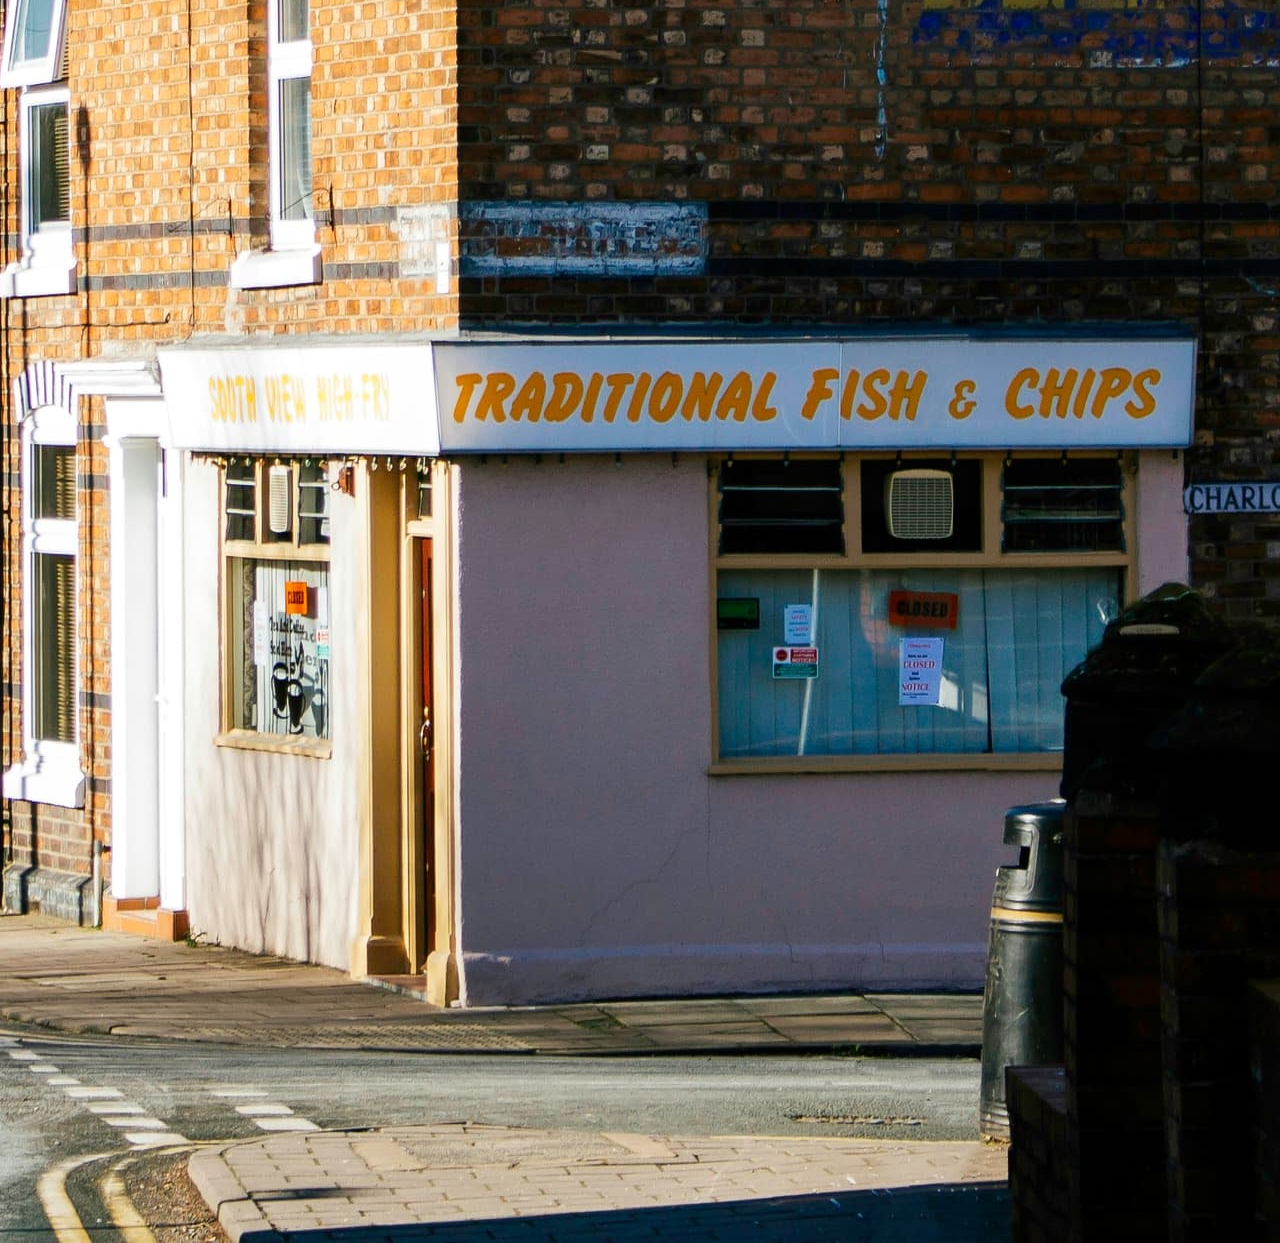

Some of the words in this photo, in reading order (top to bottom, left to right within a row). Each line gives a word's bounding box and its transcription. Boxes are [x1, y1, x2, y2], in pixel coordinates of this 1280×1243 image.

[208, 373, 257, 423] SOUTH
[264, 373, 306, 423] VIEW
[453, 371, 777, 423] TRADITIONAL
[801, 367, 927, 420] FISH
[948, 380, 977, 420] &
[1004, 367, 1161, 420] CHIPS
[287, 591, 304, 604] CLOSED
[897, 599, 948, 617] CLOSED
[903, 660, 935, 669] CLOSED
[902, 683, 930, 692] NOTICE
